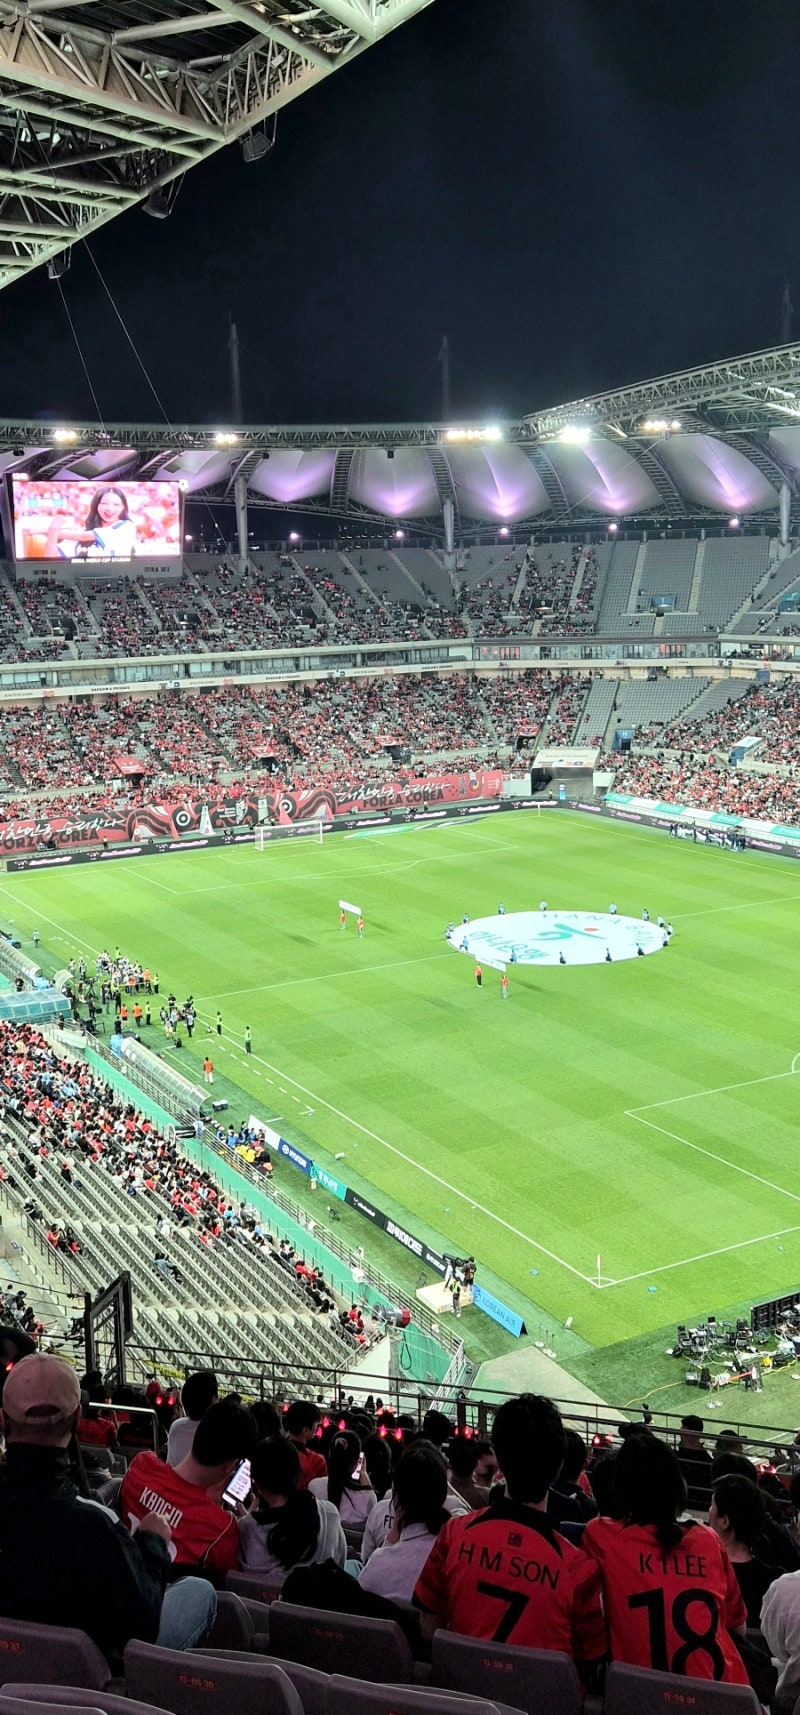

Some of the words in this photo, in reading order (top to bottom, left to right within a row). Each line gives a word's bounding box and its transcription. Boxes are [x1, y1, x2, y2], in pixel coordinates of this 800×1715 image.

[335, 784, 396, 803] 대한민국
[362, 795, 403, 808] FORZA
[406, 788, 445, 804] COREA
[468, 931, 551, 960] 하나은행
[482, 1299, 505, 1319] KOREAN
[505, 1315, 517, 1327] AIR
[139, 1486, 183, 1529] KANGIN
[458, 1540, 475, 1564] H
[479, 1546, 503, 1572] M
[508, 1556, 560, 1590] SON
[639, 1552, 654, 1574] K
[476, 1580, 530, 1644] 7
[627, 1587, 726, 1681] 18
